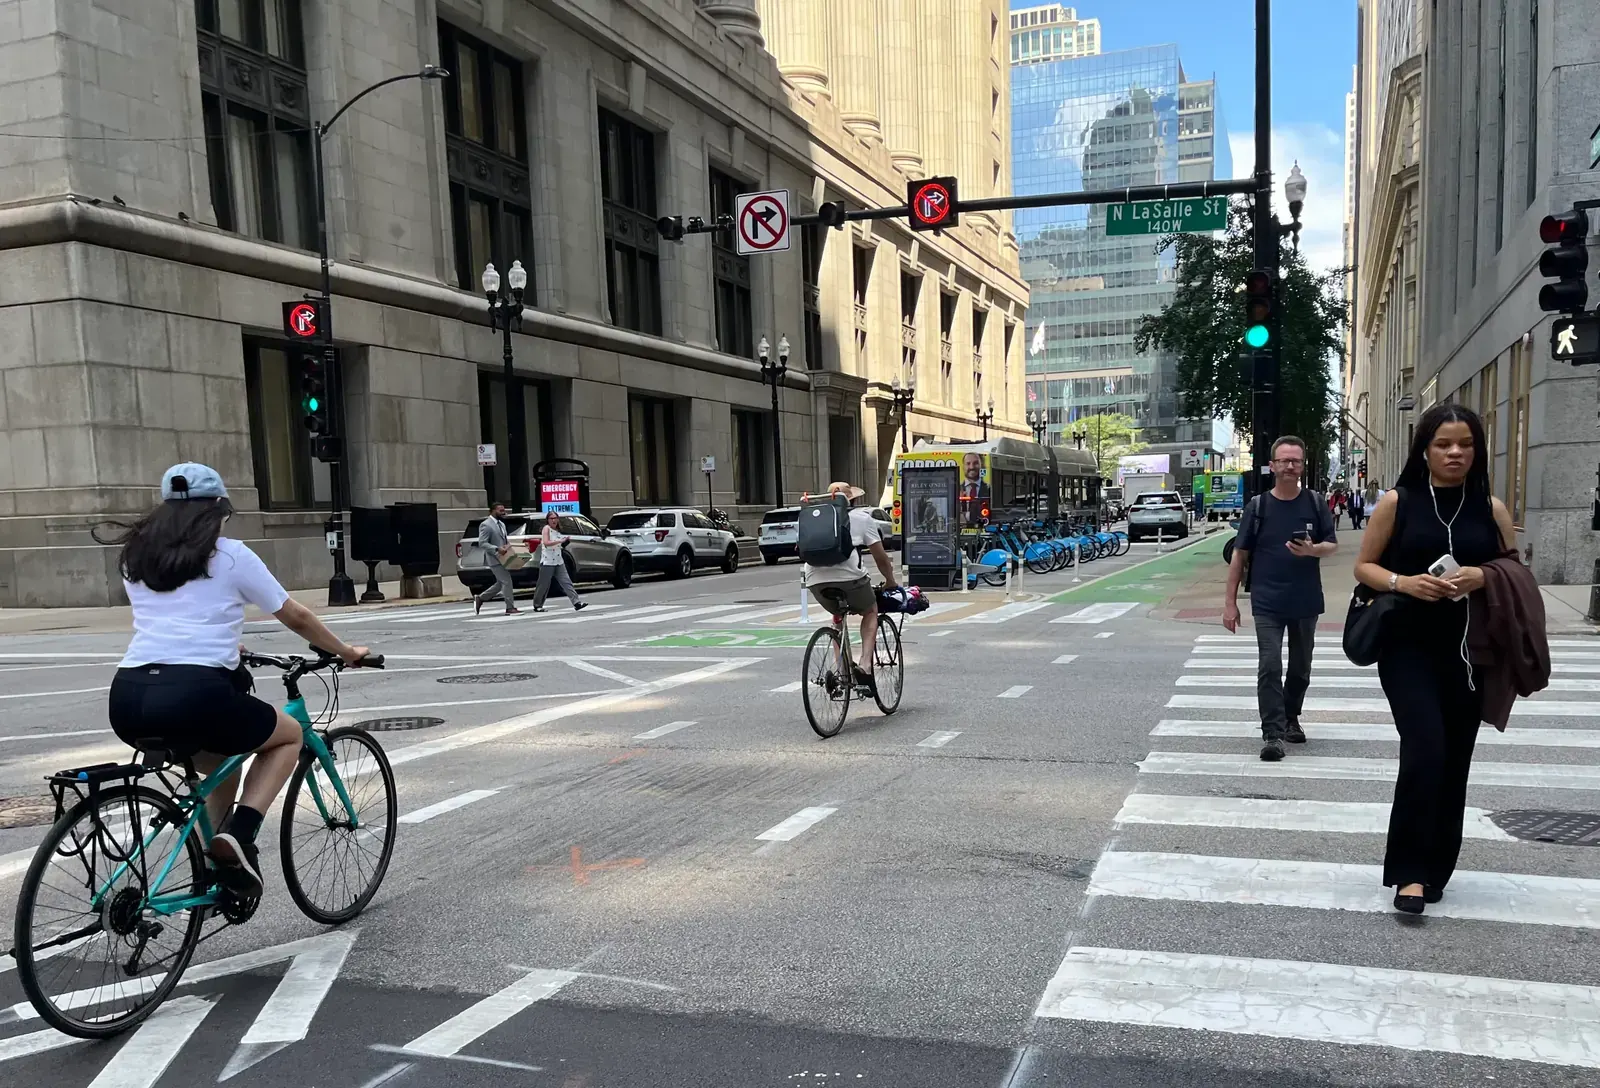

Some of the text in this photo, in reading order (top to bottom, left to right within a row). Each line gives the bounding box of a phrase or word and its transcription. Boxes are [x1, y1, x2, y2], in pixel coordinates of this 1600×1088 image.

[1113, 199, 1220, 221] N LaSalle St
[1147, 219, 1183, 233] 140W
[543, 484, 577, 492] EMERGENCY
[552, 493, 569, 501] ALERT
